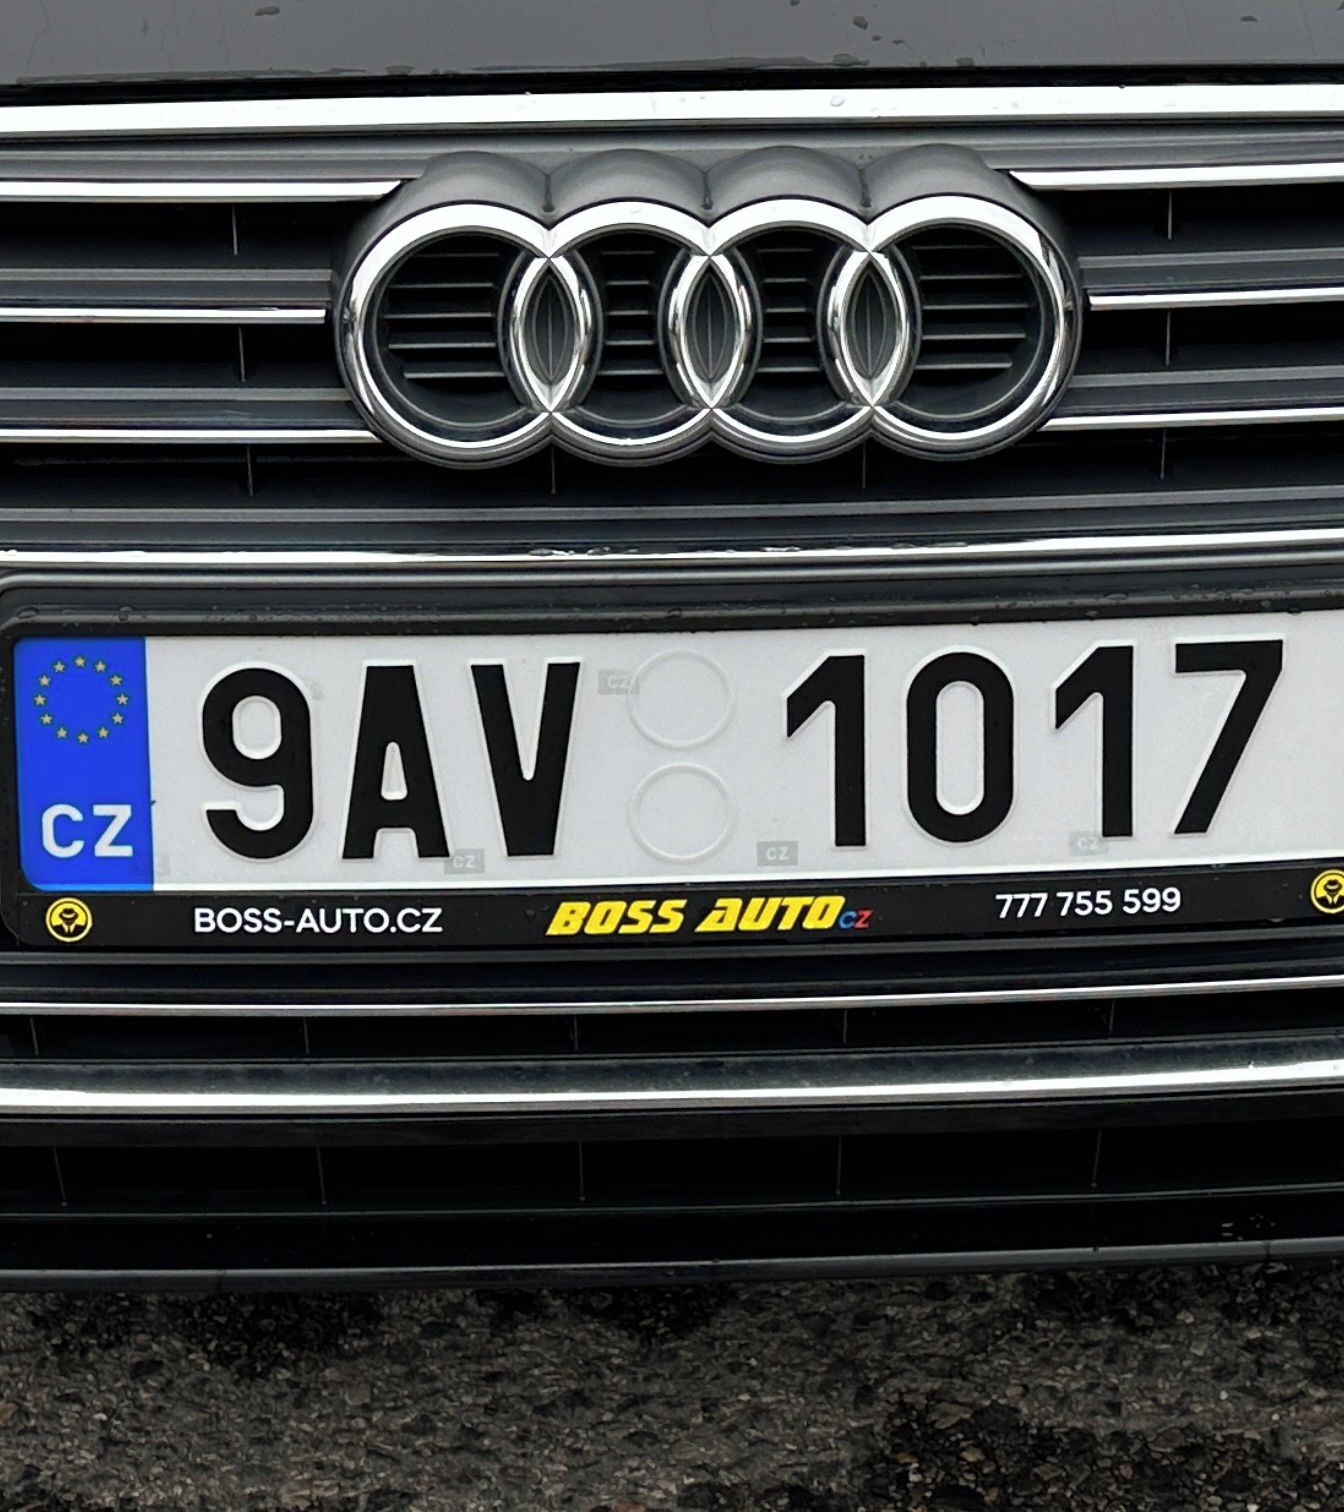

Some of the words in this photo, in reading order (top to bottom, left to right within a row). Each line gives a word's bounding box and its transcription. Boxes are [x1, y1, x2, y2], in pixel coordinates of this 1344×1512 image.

[202, 661, 581, 861] 9AV
[786, 639, 1285, 848] 1017
[42, 804, 134, 859] CZ
[194, 907, 443, 935] BOSS-AUTO.CZ
[546, 899, 688, 937] BOSS
[996, 893, 1049, 920] 777
[1057, 890, 1114, 918] 755
[1123, 887, 1182, 915] 599
